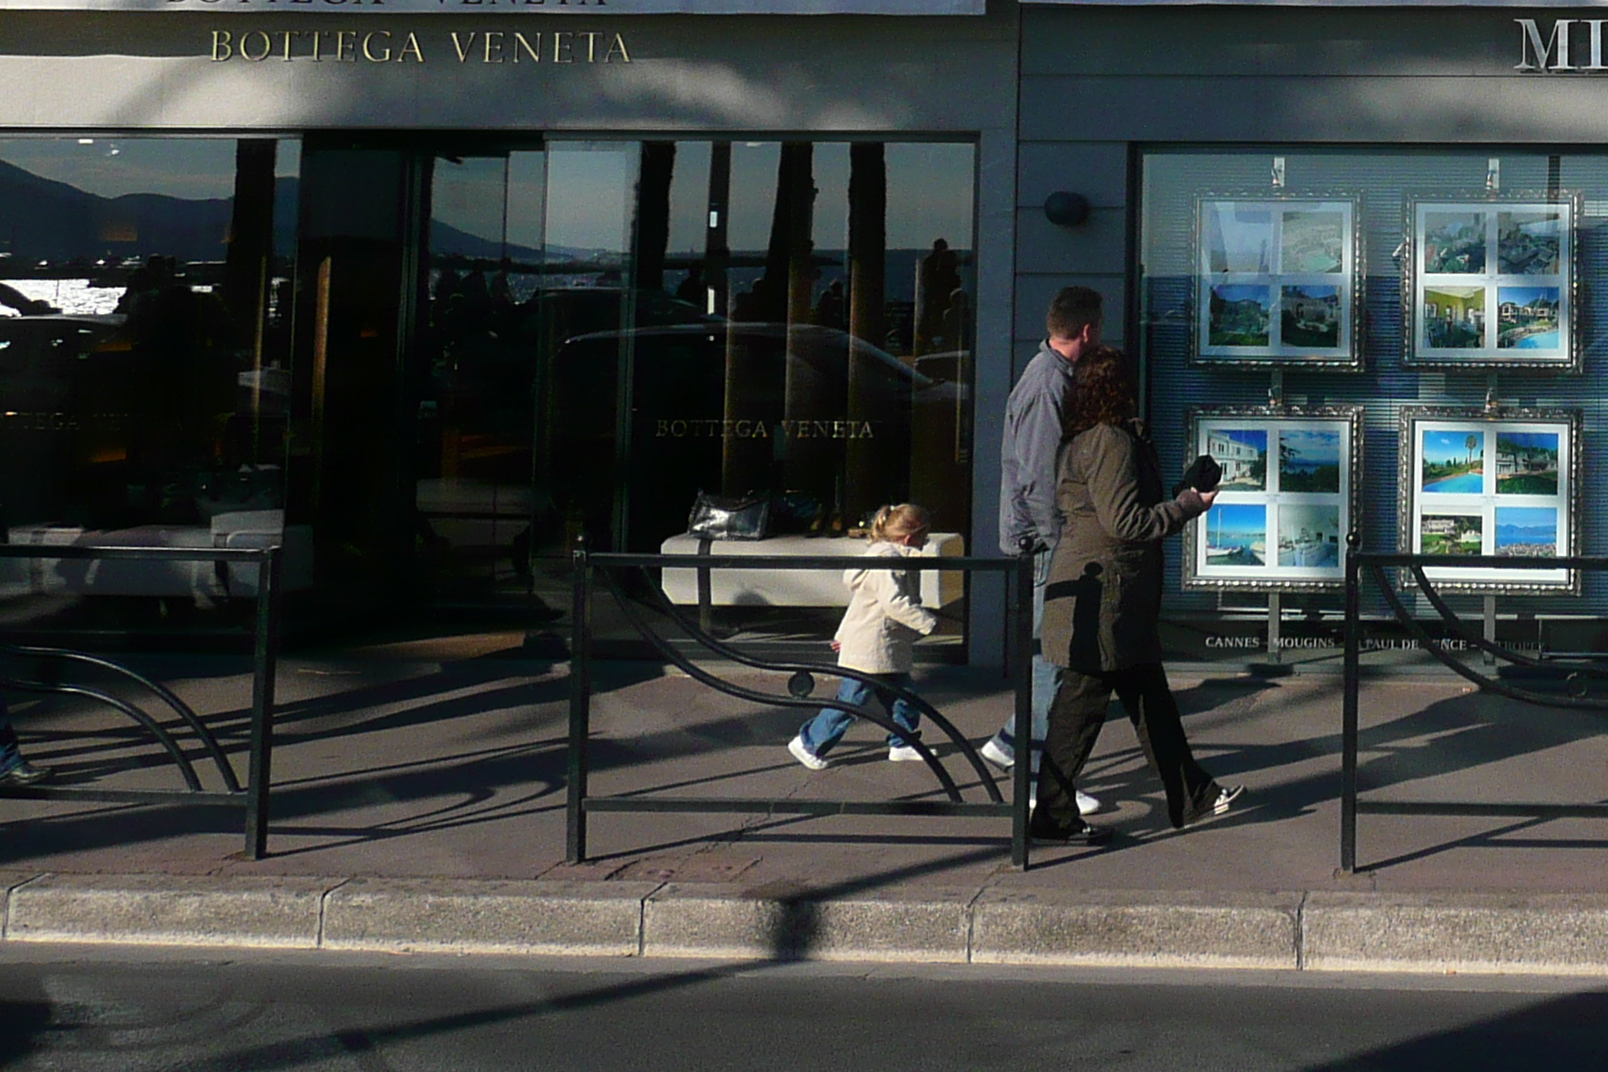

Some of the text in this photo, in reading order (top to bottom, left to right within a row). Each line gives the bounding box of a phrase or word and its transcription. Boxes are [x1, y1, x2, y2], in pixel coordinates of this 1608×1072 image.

[210, 30, 630, 64] BOTTEGA VENETA
[655, 420, 874, 438] BOTTEGA VENETA
[1205, 637, 1260, 647] CANNES
[1402, 639, 1419, 650] DE
